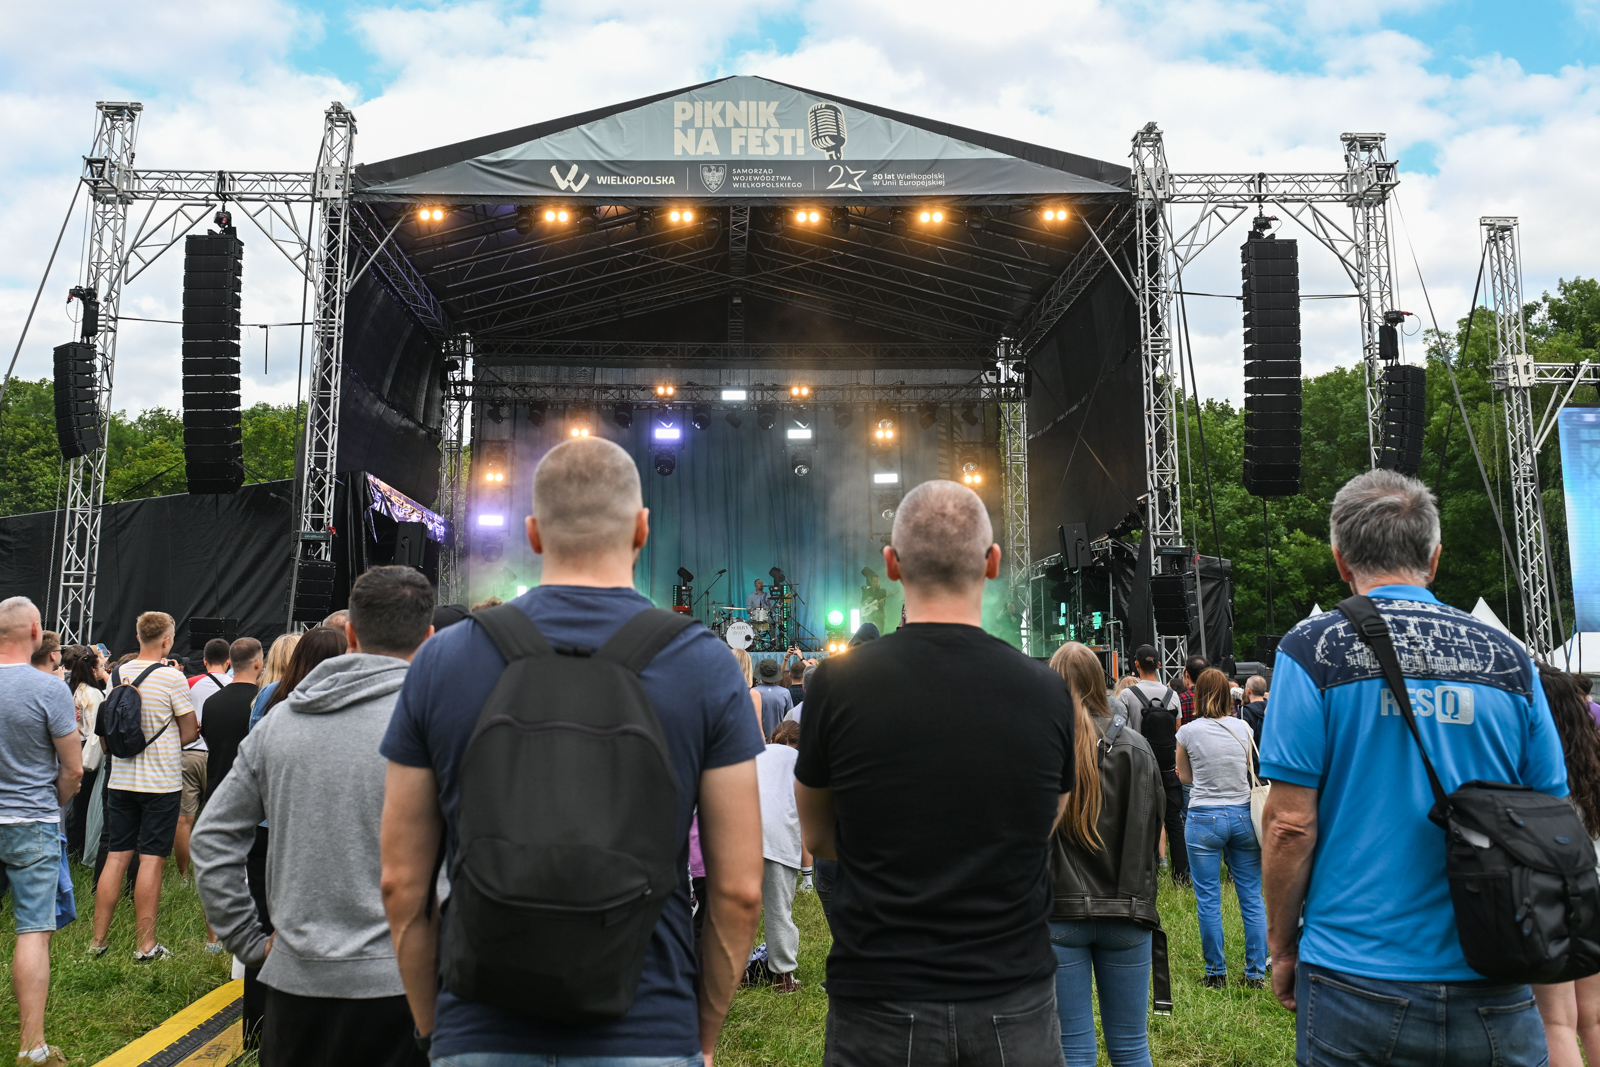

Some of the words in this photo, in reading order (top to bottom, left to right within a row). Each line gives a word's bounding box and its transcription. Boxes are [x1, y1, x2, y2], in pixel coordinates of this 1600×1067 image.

[673, 100, 780, 128] PIKNIK
[673, 128, 721, 156] NA
[731, 128, 805, 156] FEST!
[596, 176, 676, 185] WIELKOPOLSKA
[896, 172, 945, 180] Wielkopolski
[898, 179, 945, 187] Europejskiej
